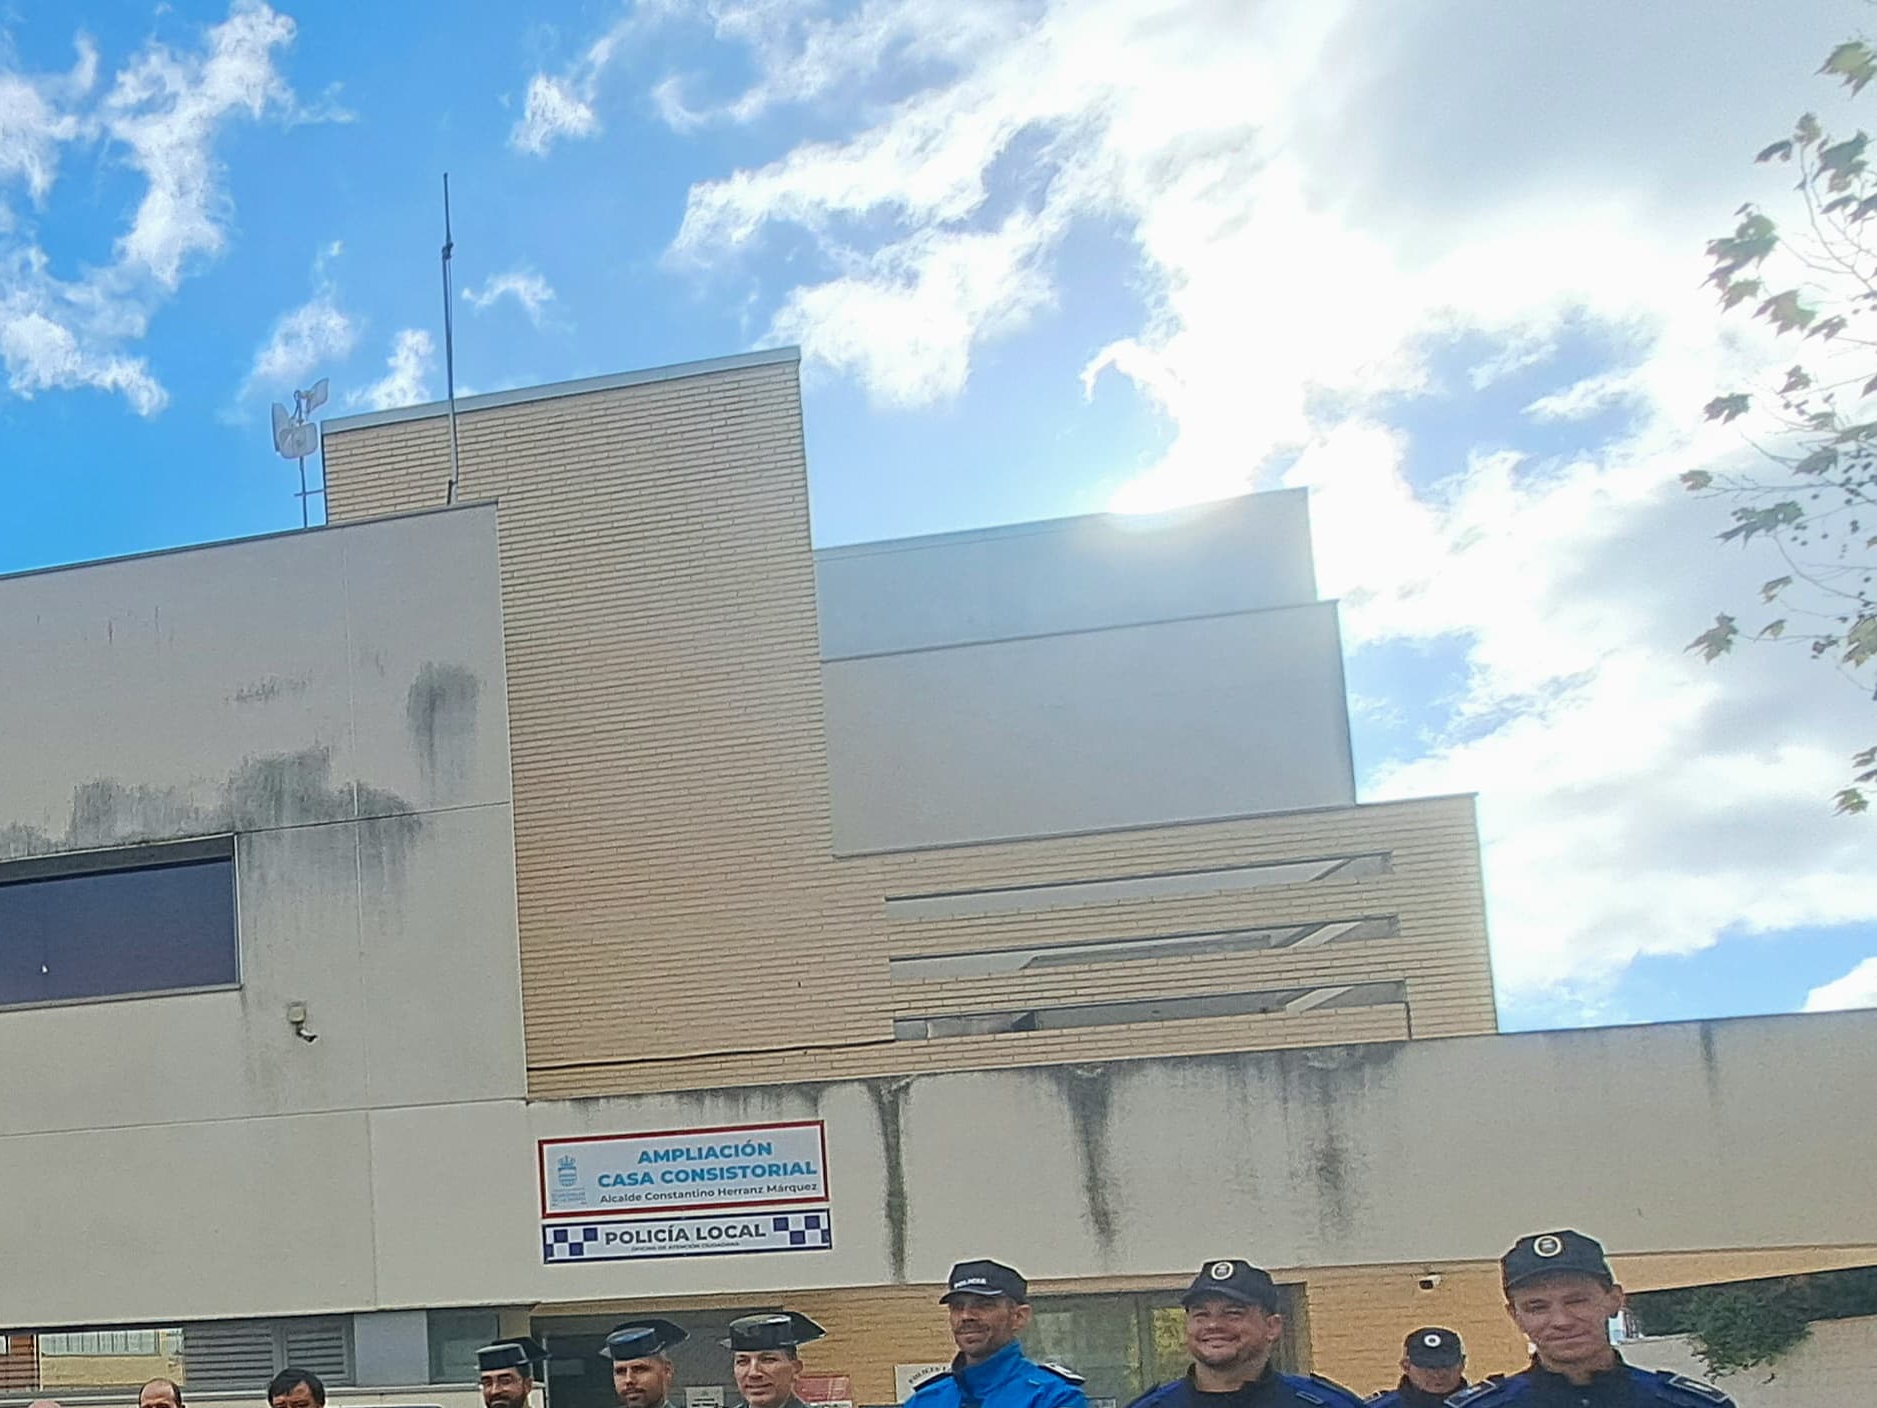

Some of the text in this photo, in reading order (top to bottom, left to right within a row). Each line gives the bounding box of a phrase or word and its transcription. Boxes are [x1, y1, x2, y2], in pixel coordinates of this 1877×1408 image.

[637, 1139, 773, 1165] AMPLIACIÓN
[597, 1161, 818, 1188] CASA CONSISTORIAL
[600, 1192, 642, 1203] Alcalde
[644, 1189, 715, 1201] Constantino
[718, 1186, 764, 1197] Herranz
[766, 1183, 817, 1194] Márquez
[605, 1223, 767, 1246] POLICÍA LOCAL
